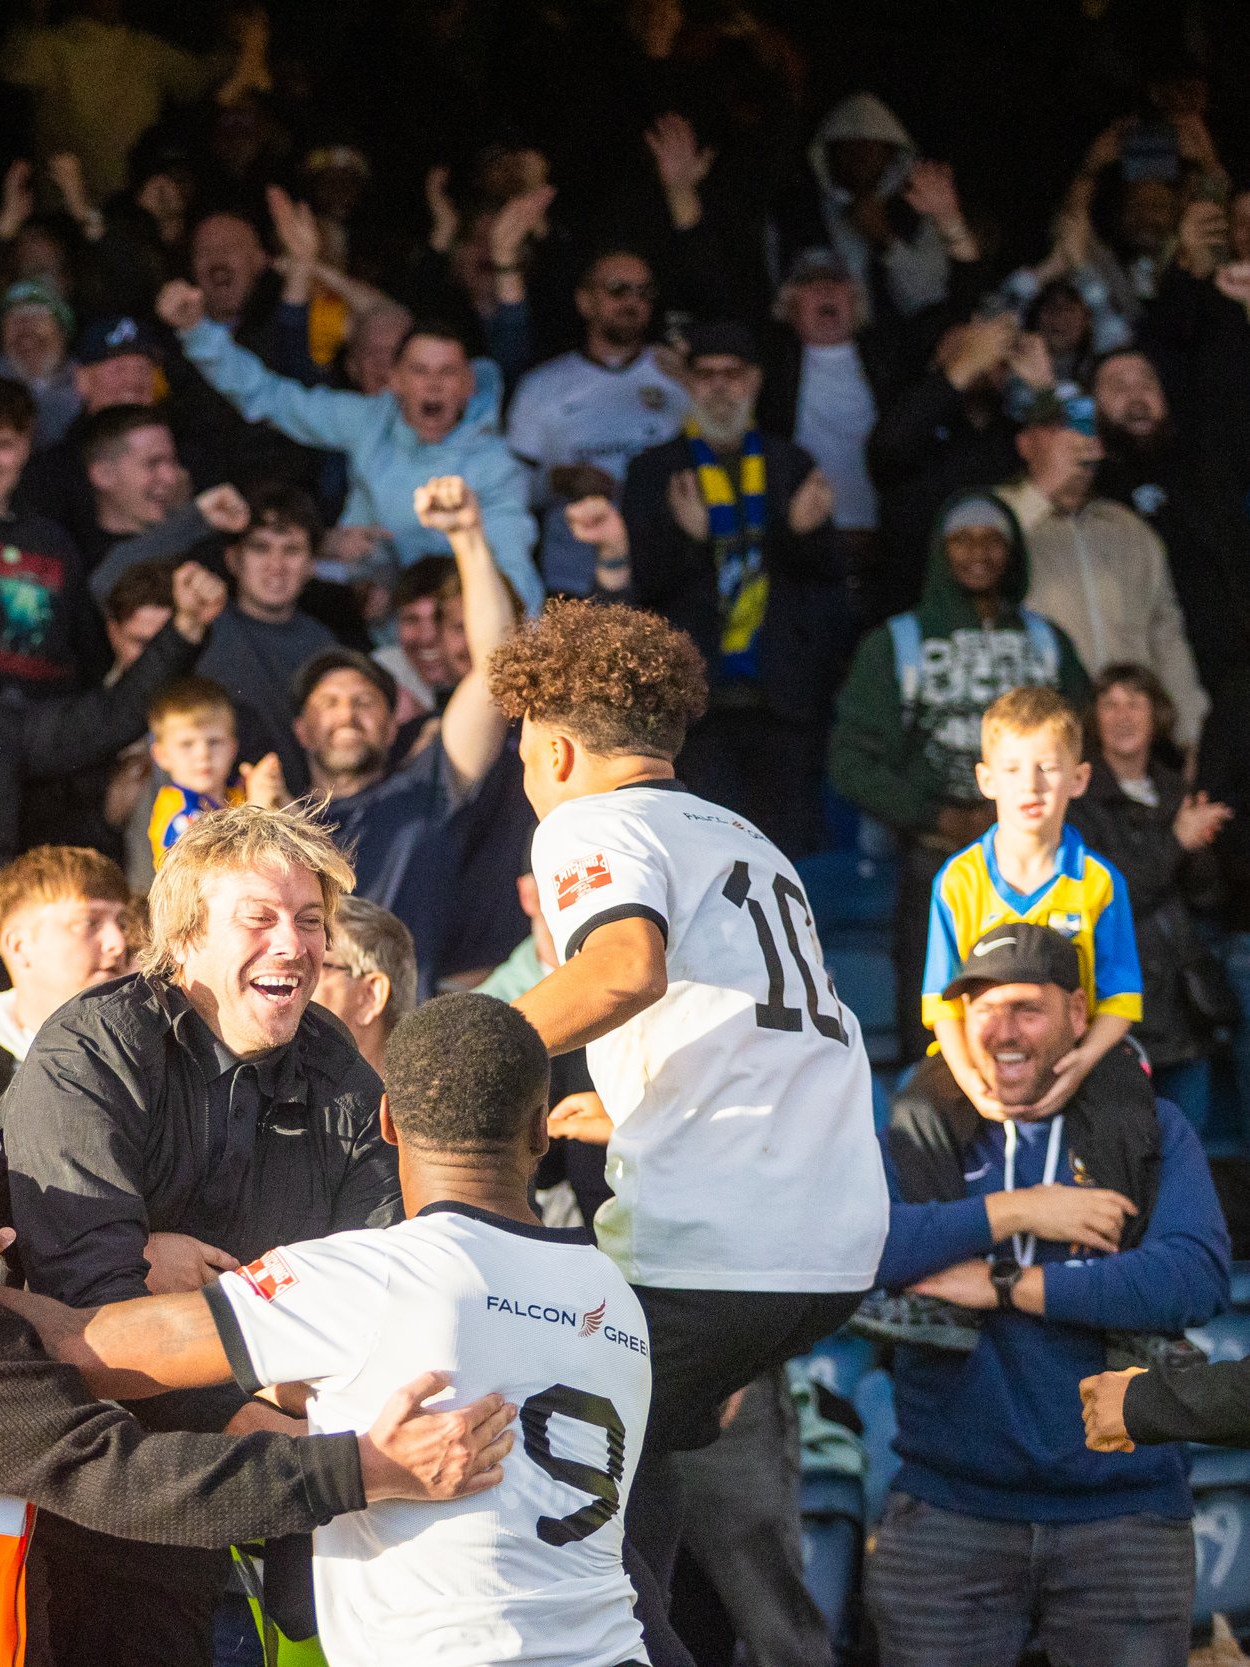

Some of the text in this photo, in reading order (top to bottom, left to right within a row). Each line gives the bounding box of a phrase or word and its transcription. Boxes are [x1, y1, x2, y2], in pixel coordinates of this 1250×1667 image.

[722, 860, 849, 1047] 10
[486, 1295, 648, 1356] FALCON GREE
[519, 1383, 626, 1547] 9
